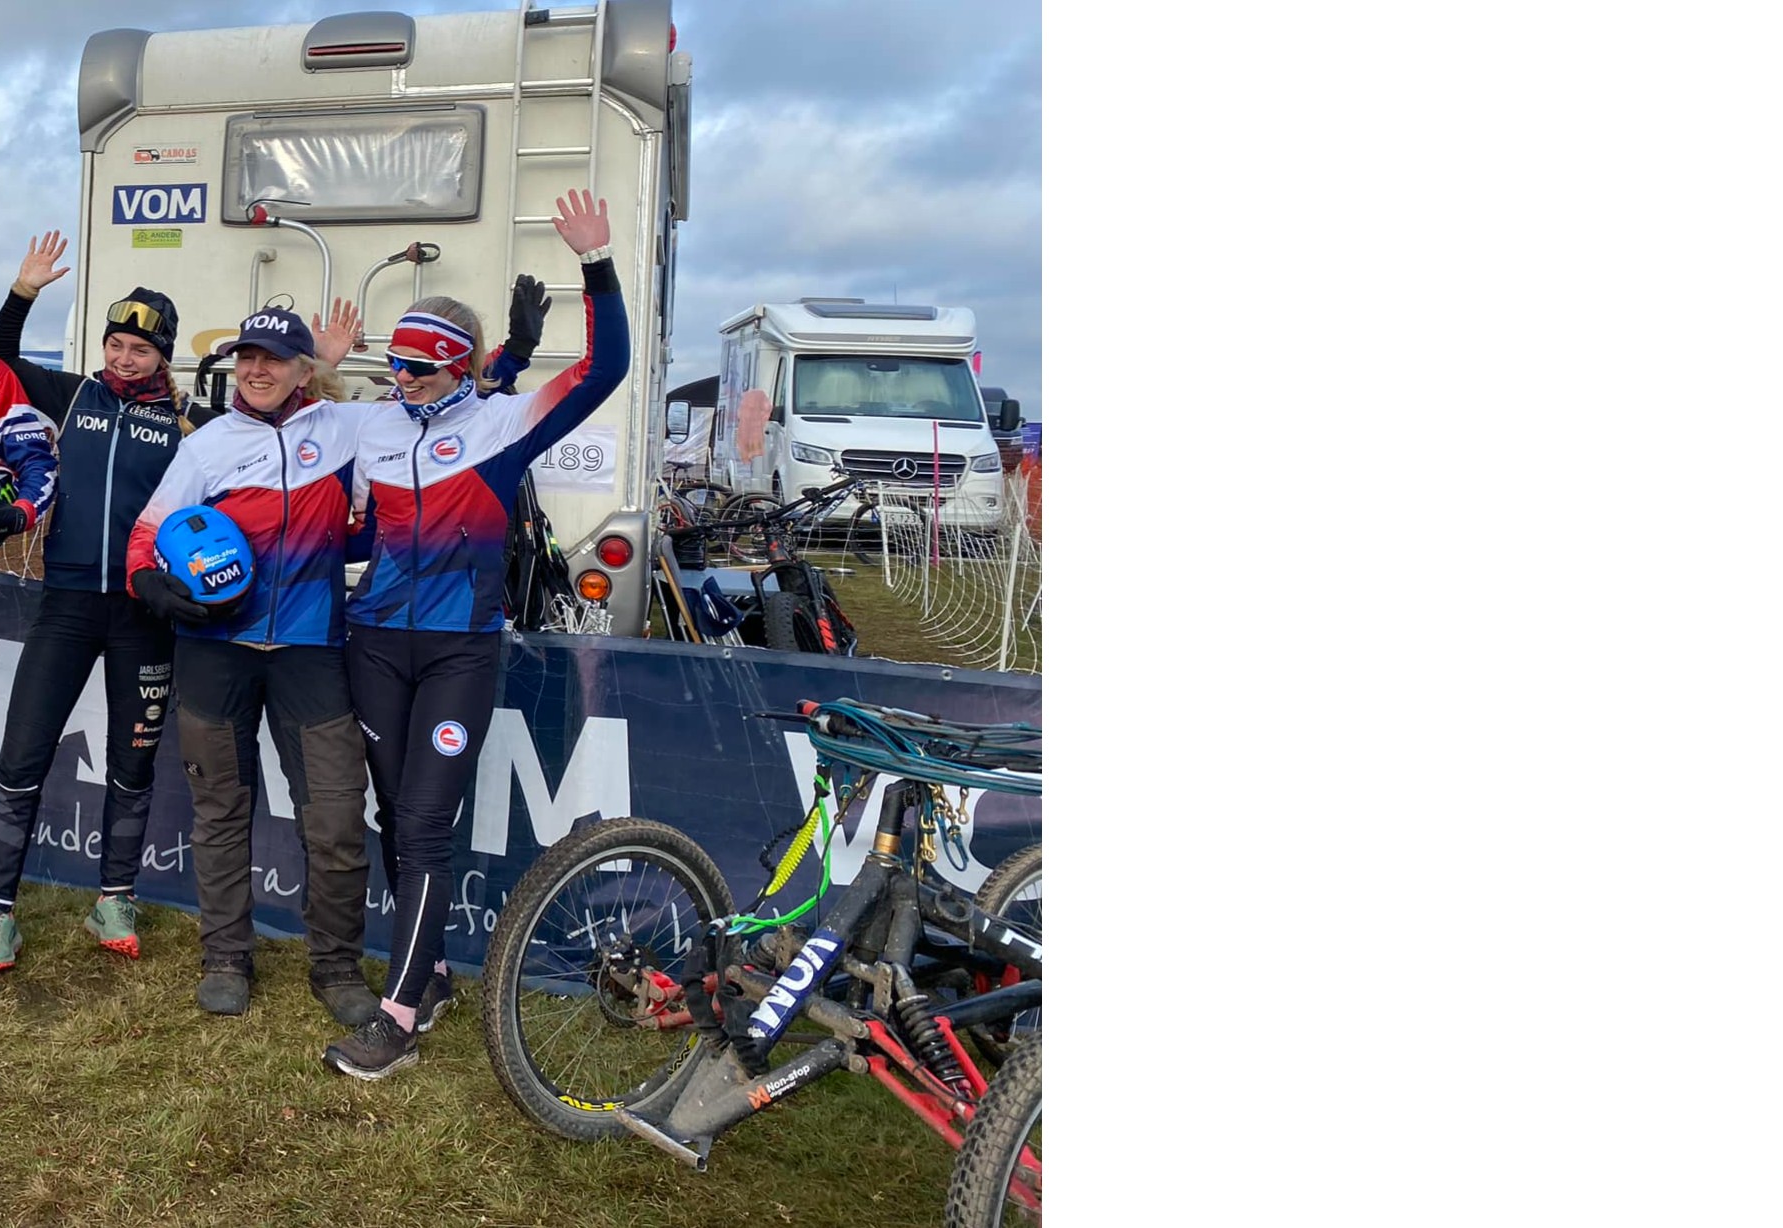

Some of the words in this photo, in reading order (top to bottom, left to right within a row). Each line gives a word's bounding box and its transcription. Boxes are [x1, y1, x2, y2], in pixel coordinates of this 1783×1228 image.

[118, 187, 202, 220] VOM
[245, 315, 289, 334] VOM
[77, 414, 109, 432] VOM
[129, 406, 173, 425] LEEGAARD
[16, 432, 47, 442] NORG
[130, 423, 169, 447] VOM
[540, 443, 604, 472] 189
[204, 547, 238, 564] Non-stop
[205, 564, 241, 588] VOM
[139, 684, 169, 699] VOM
[766, 1065, 811, 1093] Non-stop
[769, 1081, 797, 1098] dogwear
